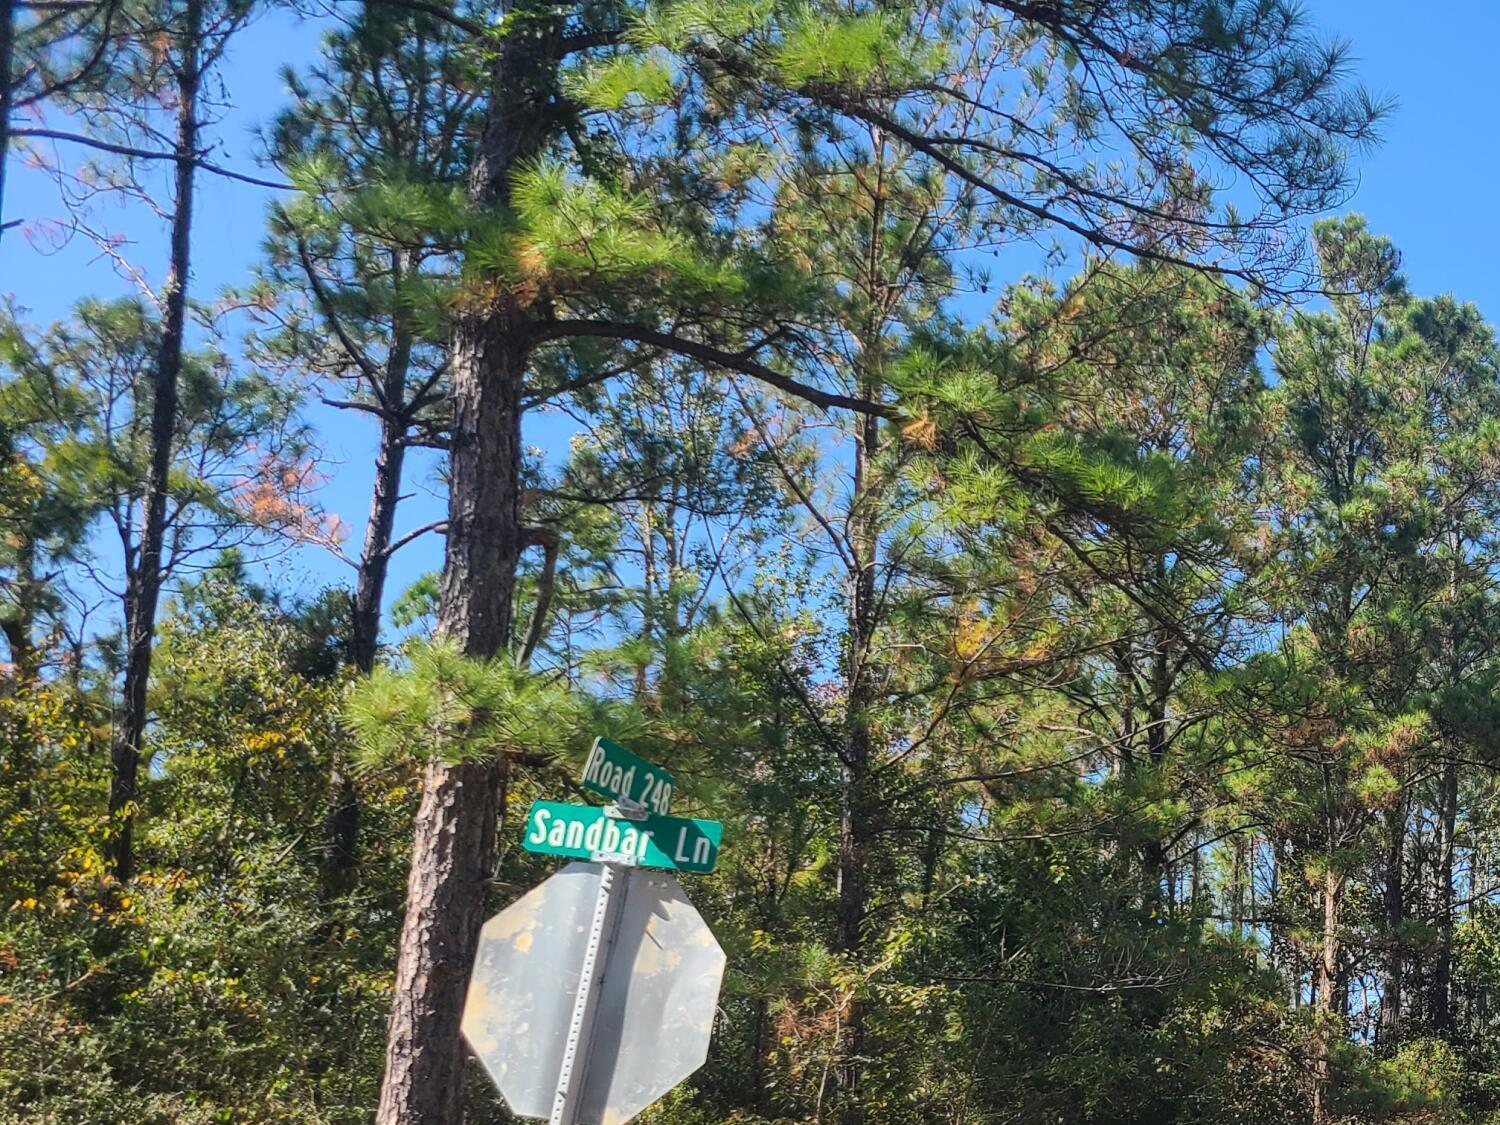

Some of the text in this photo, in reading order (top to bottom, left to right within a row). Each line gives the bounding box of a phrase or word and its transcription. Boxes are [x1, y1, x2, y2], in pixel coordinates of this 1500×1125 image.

[586, 747, 672, 815] Road 248
[529, 808, 711, 865] Sandbar Ln
